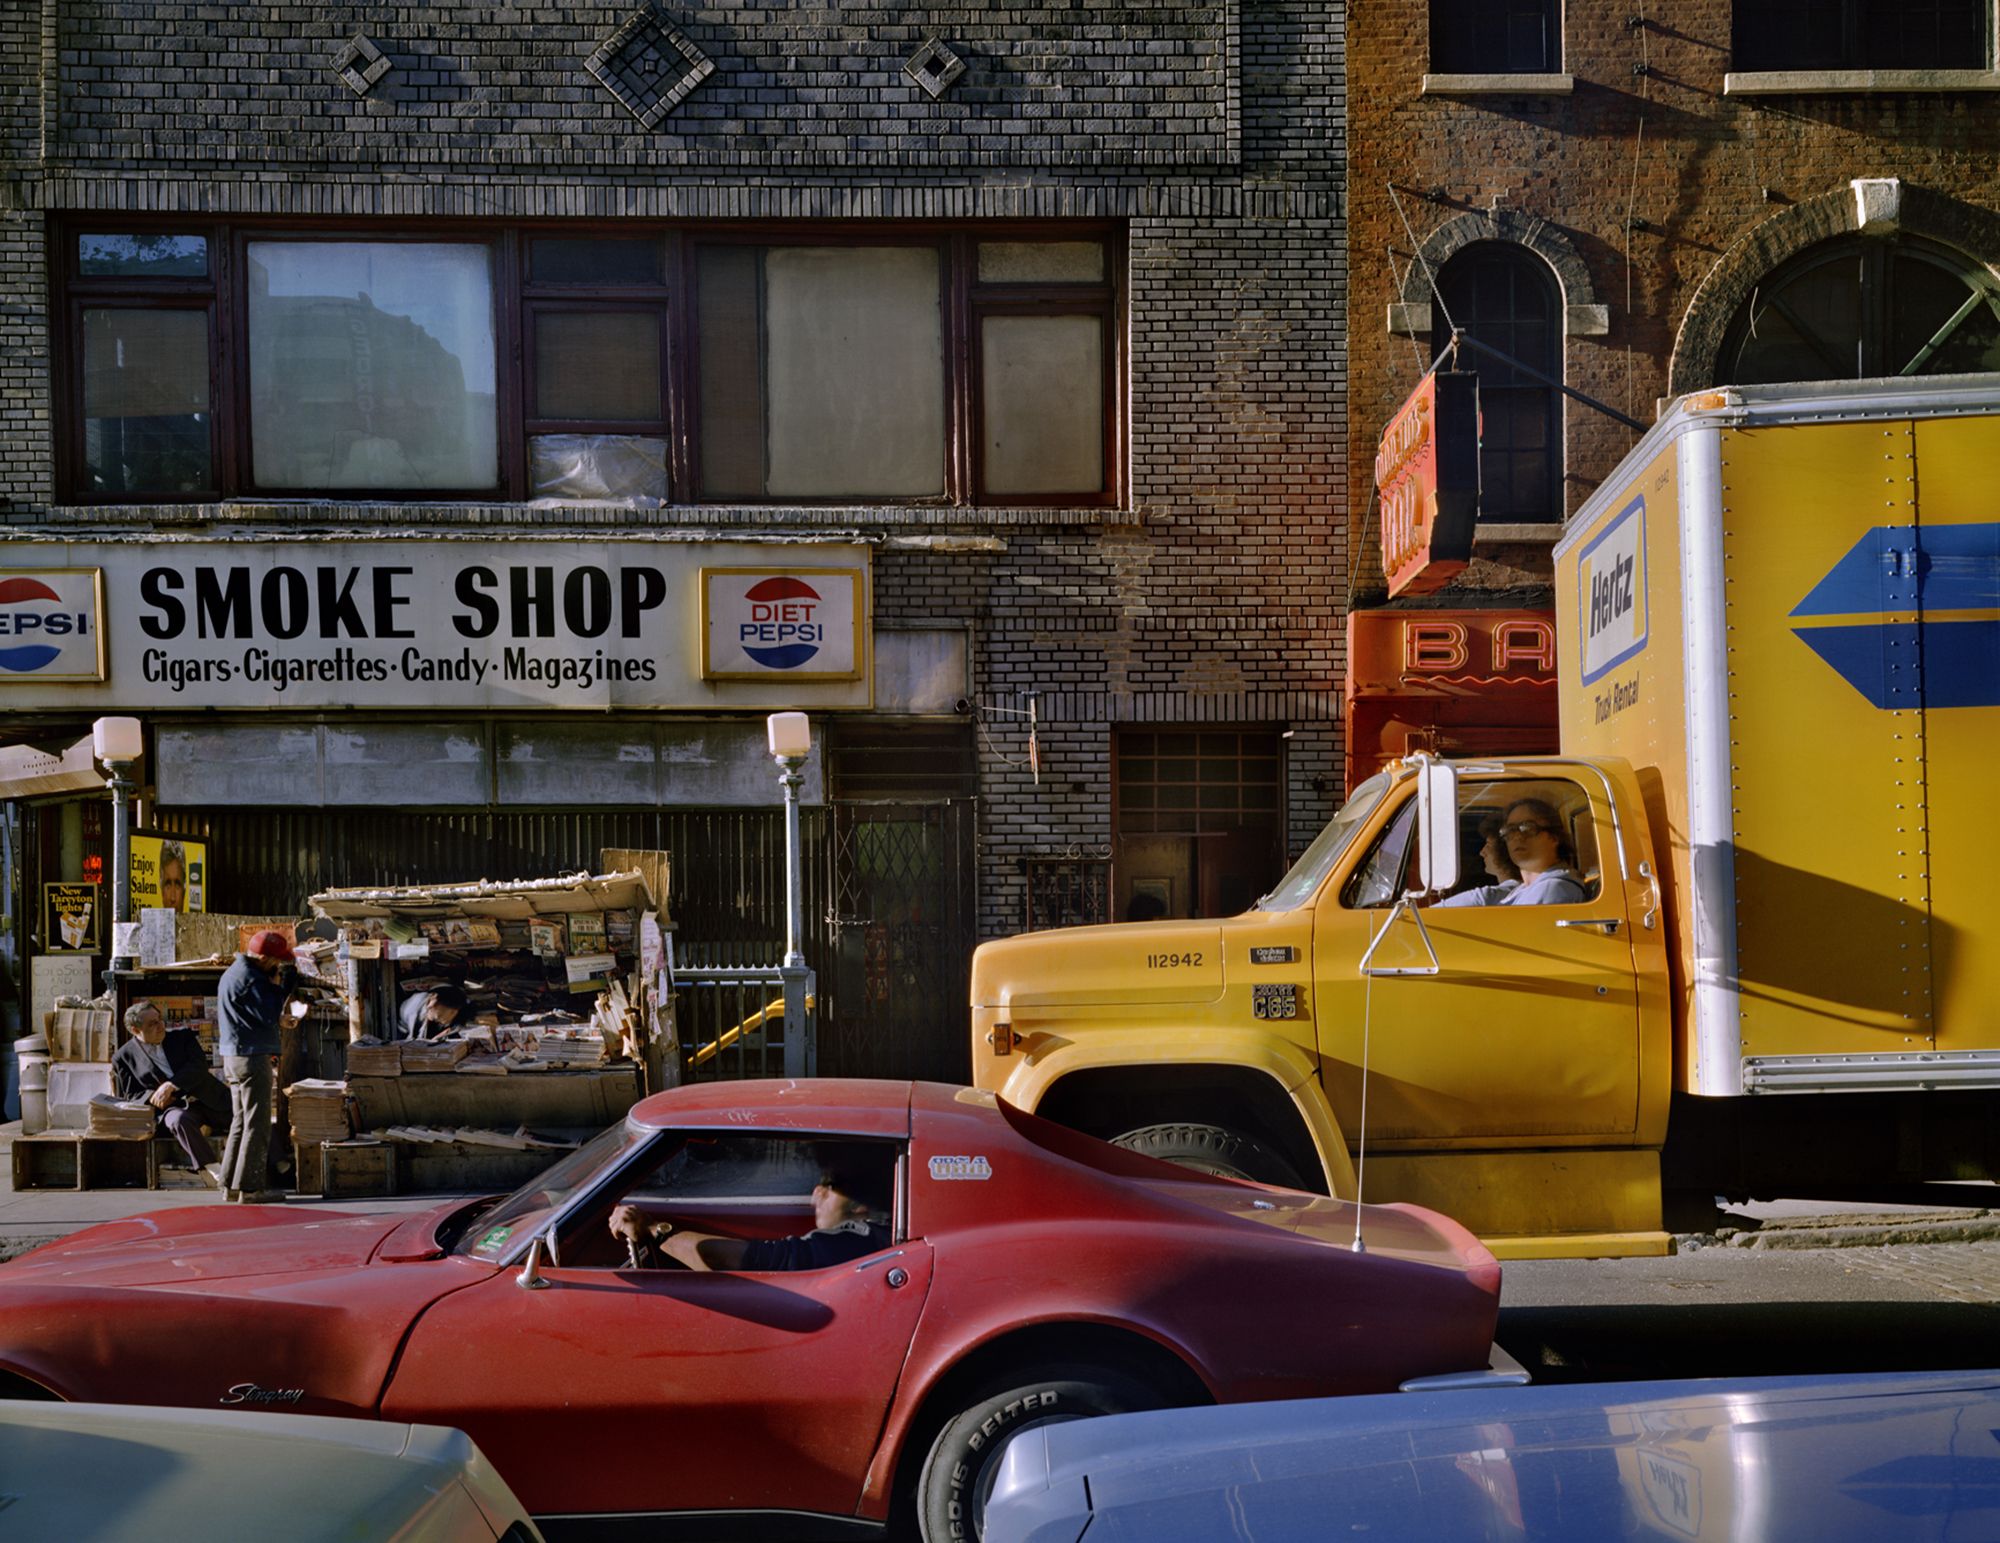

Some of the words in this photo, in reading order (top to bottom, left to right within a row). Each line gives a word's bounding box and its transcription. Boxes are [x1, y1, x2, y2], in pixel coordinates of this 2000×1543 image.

[139, 566, 415, 640] SMOKE
[452, 565, 667, 639] SHOP
[1590, 553, 1633, 638] Hertz
[0, 613, 87, 635] PSI
[752, 605, 816, 622] DIET
[740, 624, 823, 641] PEPSI
[1402, 619, 1556, 672] BA
[1594, 687, 1612, 726] Truck
[1612, 670, 1640, 715] Rental
[131, 853, 156, 876] Enjoy
[60, 886, 82, 896] New
[131, 876, 158, 895] Salem
[50, 894, 93, 904] Tareyton
[55, 902, 83, 913] lights
[1147, 953, 1203, 969] 112942
[1253, 995, 1296, 1018] C65
[219, 1383, 304, 1404] Stingray
[968, 1390, 1058, 1451] BELTED
